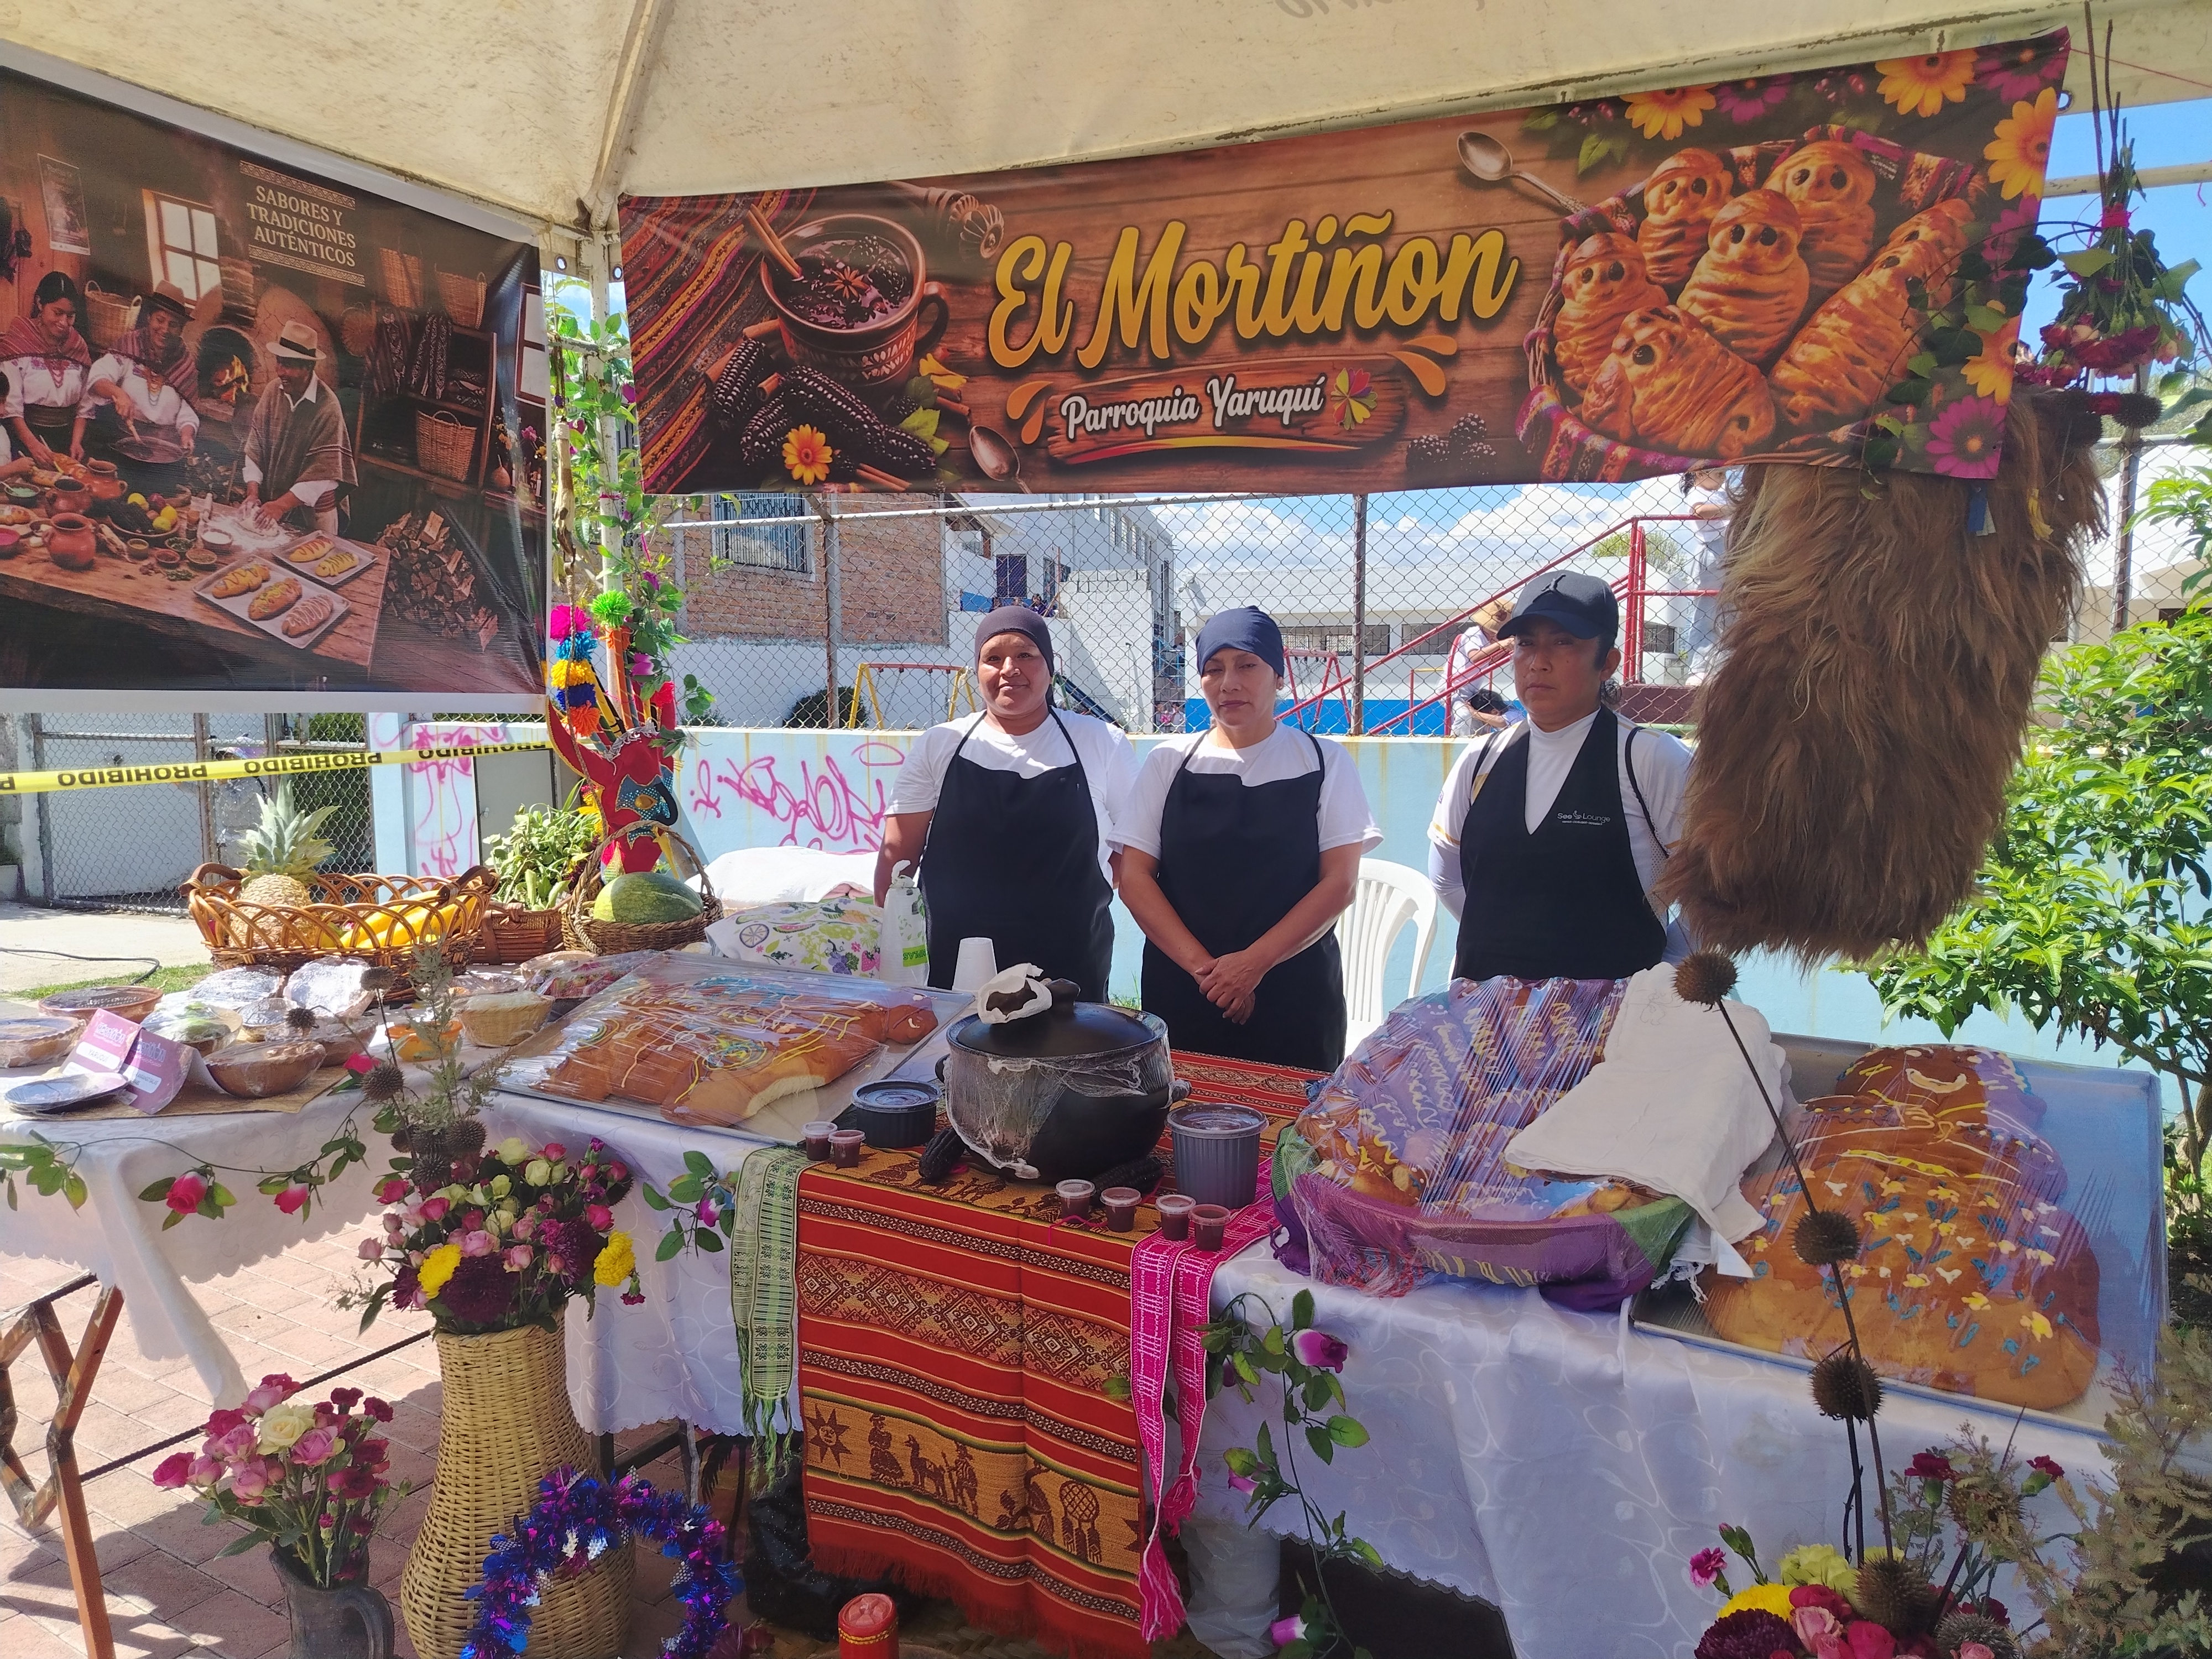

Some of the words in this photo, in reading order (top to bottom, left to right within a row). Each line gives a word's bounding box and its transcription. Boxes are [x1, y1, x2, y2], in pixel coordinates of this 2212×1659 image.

[247, 202, 356, 248] TRADICIONES
[256, 185, 330, 222] SABORES
[333, 210, 343, 226] Y
[254, 225, 356, 267] AUTÉNTICOS
[988, 235, 1073, 368] El
[1077, 211, 1519, 368] Mortiñon
[1061, 388, 1199, 440] Parroquia
[1207, 377, 1325, 427] Yaruquí
[58, 765, 207, 786] PROHIBIDO
[244, 752, 383, 774] PROHIBIDO
[1583, 813, 1610, 823] Lounge
